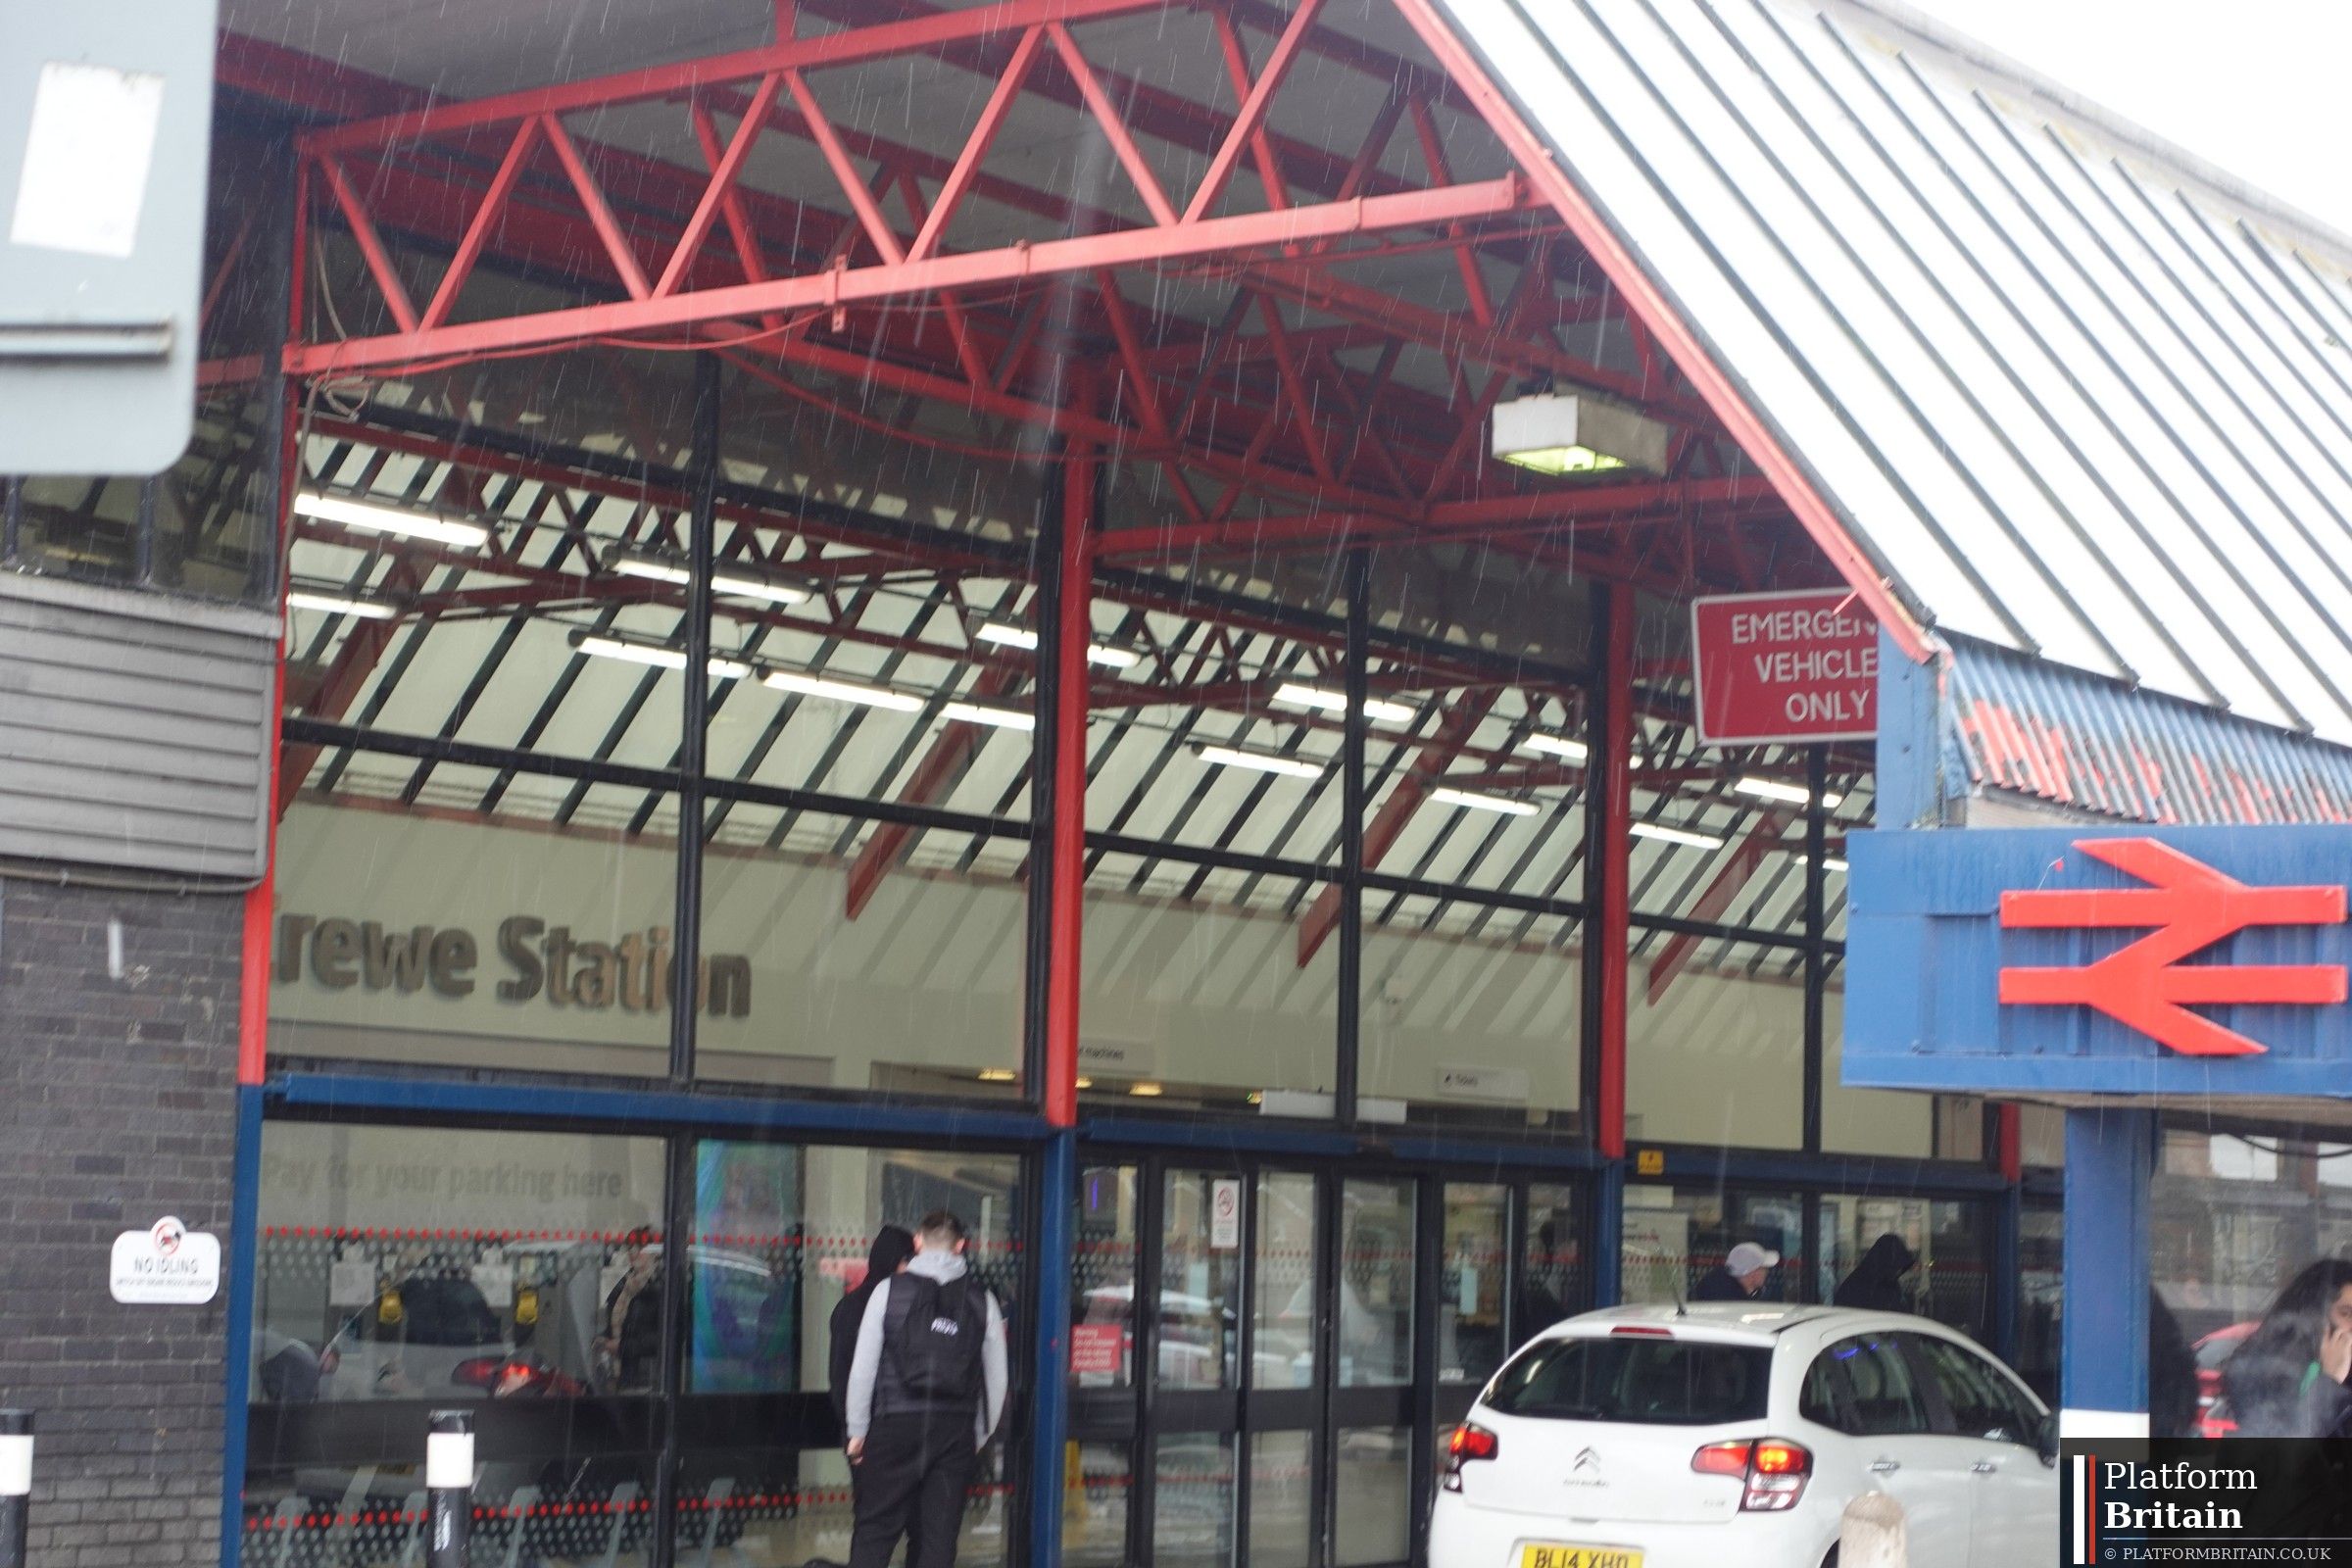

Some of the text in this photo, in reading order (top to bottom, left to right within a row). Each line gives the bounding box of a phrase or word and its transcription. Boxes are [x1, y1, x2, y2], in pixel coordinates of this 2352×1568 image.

[1785, 689, 1870, 722] ONLY
[274, 911, 478, 998] rewe
[374, 1163, 439, 1200] your
[449, 1160, 556, 1203] parking
[562, 1161, 622, 1198] here
[133, 1256, 199, 1274] NO IDLING
